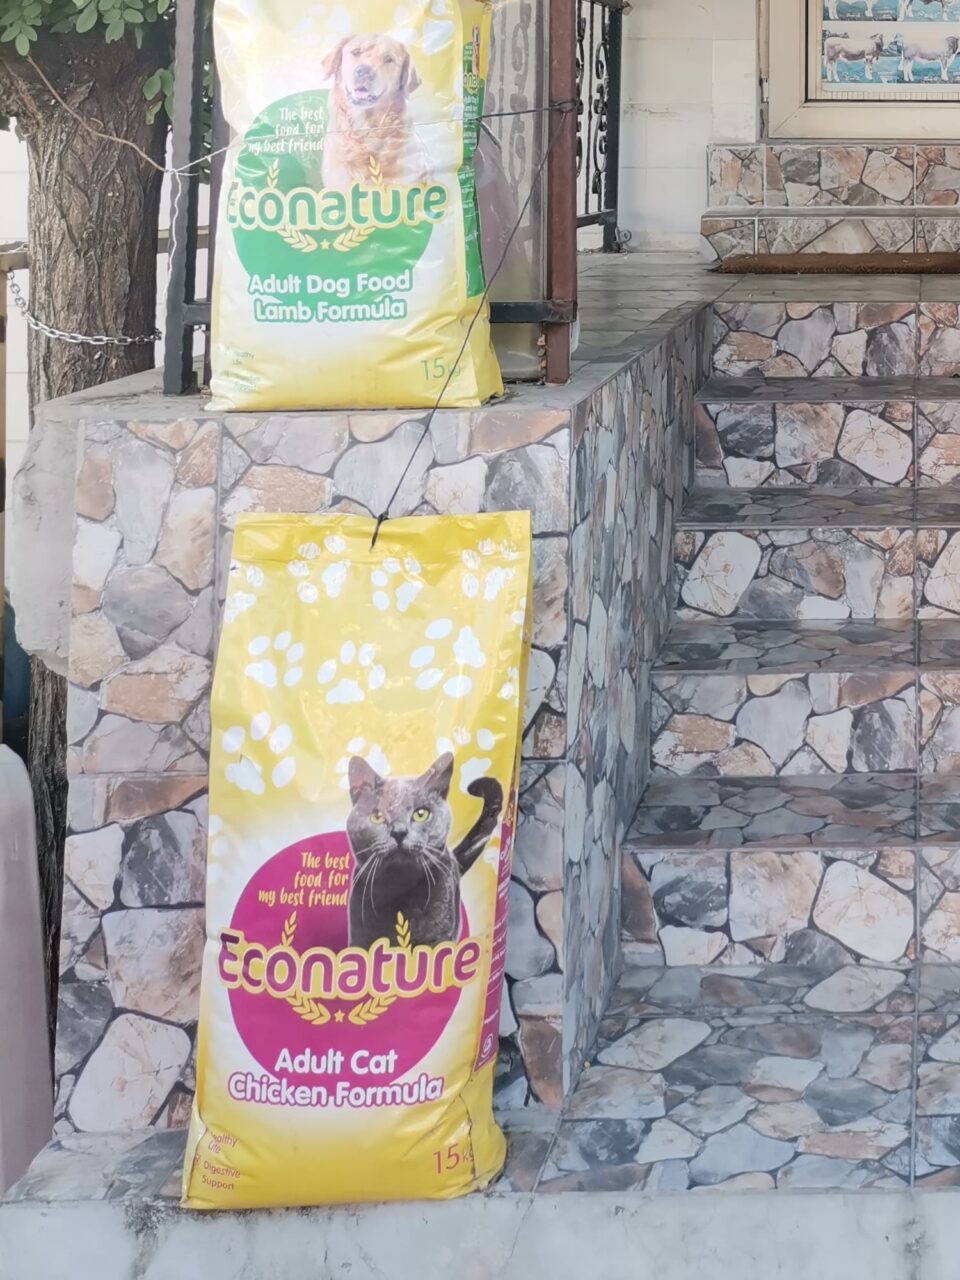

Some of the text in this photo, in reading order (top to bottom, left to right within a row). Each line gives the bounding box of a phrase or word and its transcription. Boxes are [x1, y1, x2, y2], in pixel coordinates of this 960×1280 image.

[279, 106, 324, 121] The best
[275, 121, 324, 138] food for
[263, 139, 285, 153] best
[288, 138, 324, 153] friend
[249, 270, 410, 297] Adult Dog Food
[255, 298, 405, 321] Lamb Formula
[301, 851, 350, 870] The best
[293, 869, 349, 889] food for
[258, 886, 349, 908] my best friend
[218, 931, 481, 994] Econature
[273, 1047, 399, 1075] Adult Cat
[229, 1073, 445, 1107] Chicken Formula
[203, 1160, 241, 1179] Digestive
